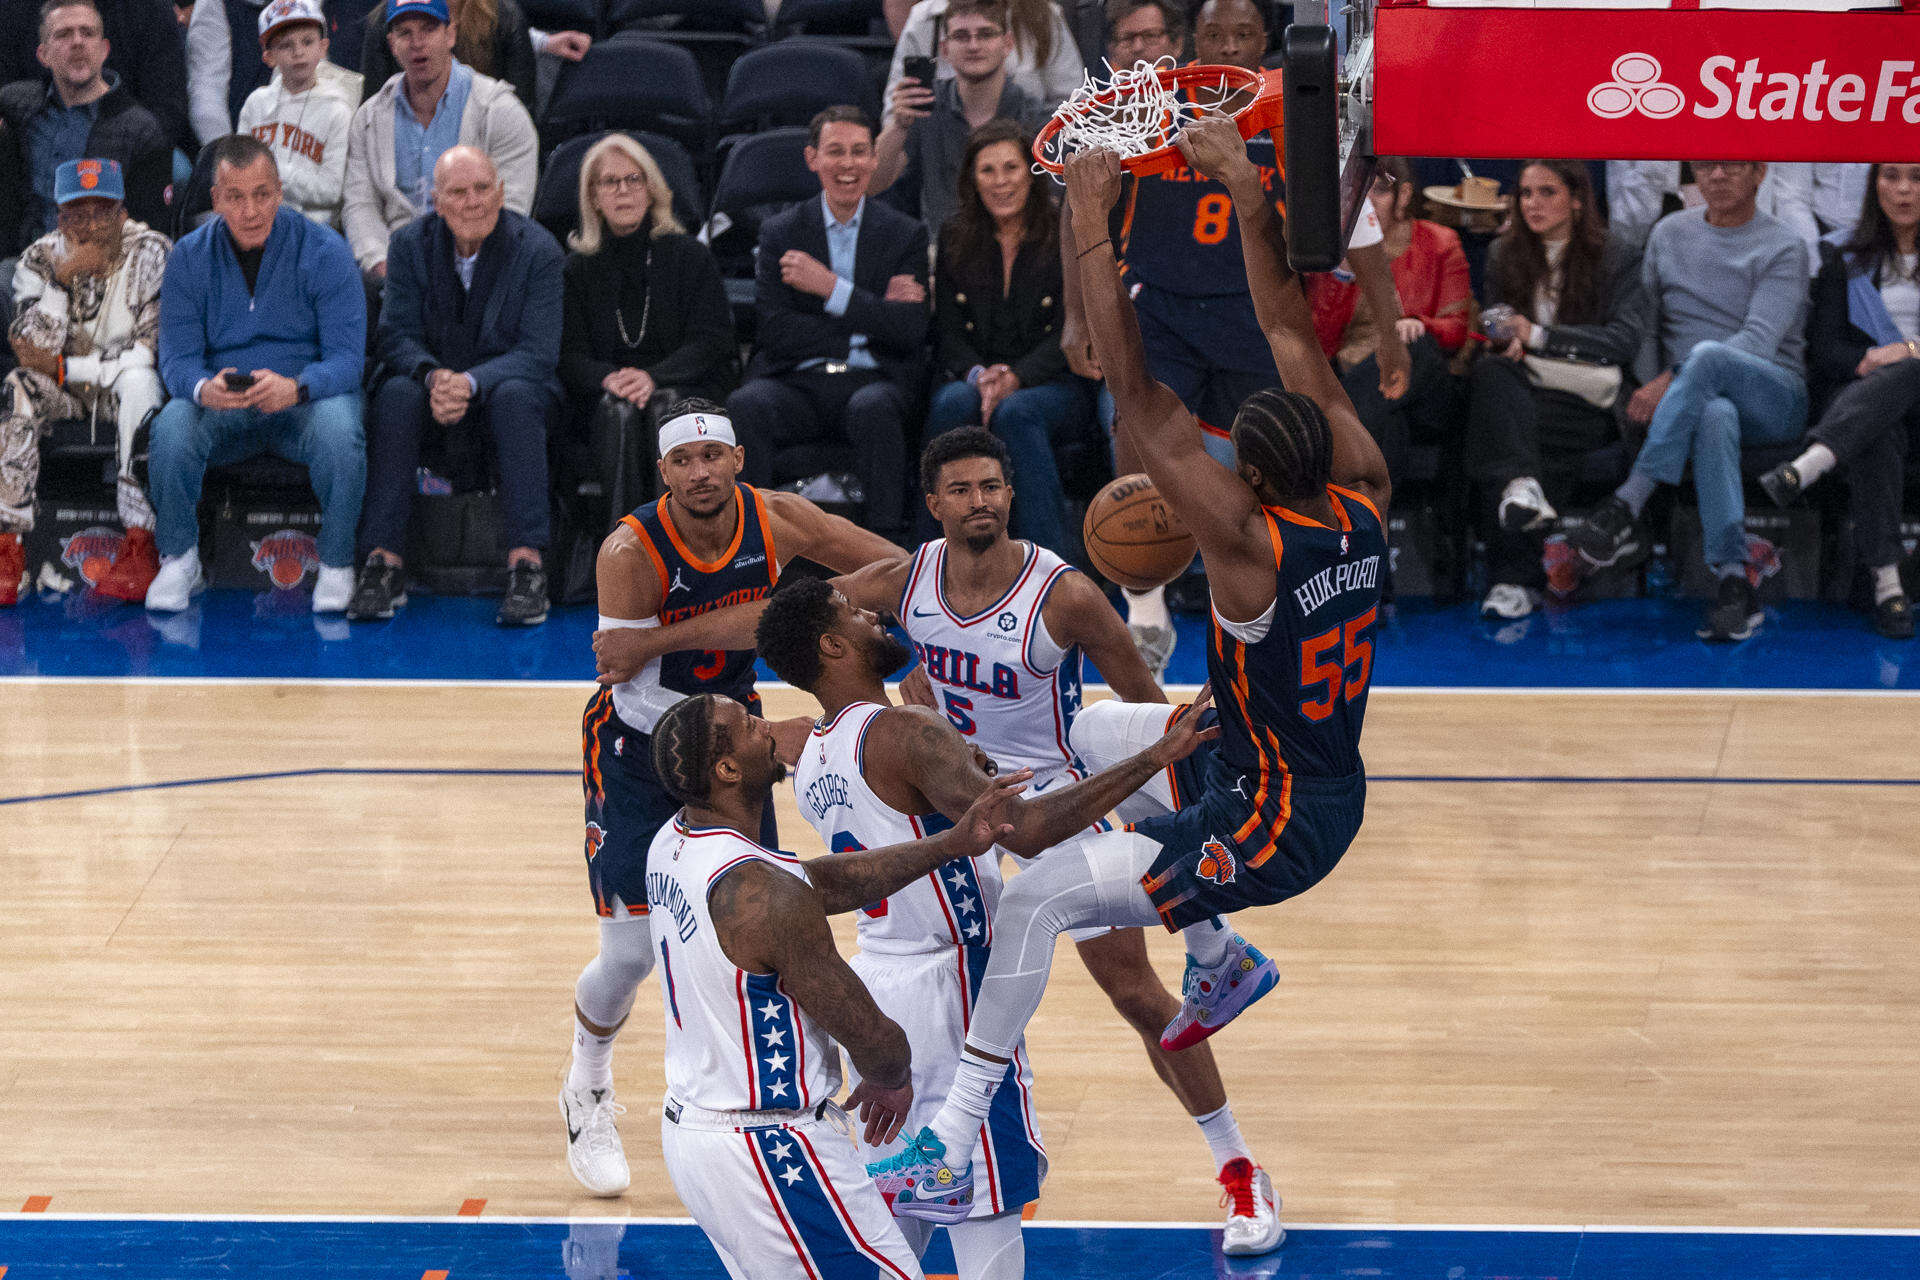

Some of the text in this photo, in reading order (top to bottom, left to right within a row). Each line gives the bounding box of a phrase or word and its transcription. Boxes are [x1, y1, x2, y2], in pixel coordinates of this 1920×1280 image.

[1693, 55, 1866, 122] State
[282, 121, 325, 164] YORK
[1193, 193, 1232, 245] 8
[986, 631, 1022, 643] crypto.com
[1300, 603, 1377, 722] 55
[942, 688, 977, 736] 5
[805, 773, 854, 820] GEORGE
[647, 872, 698, 944] UMMOND
[660, 935, 683, 1032] 1
